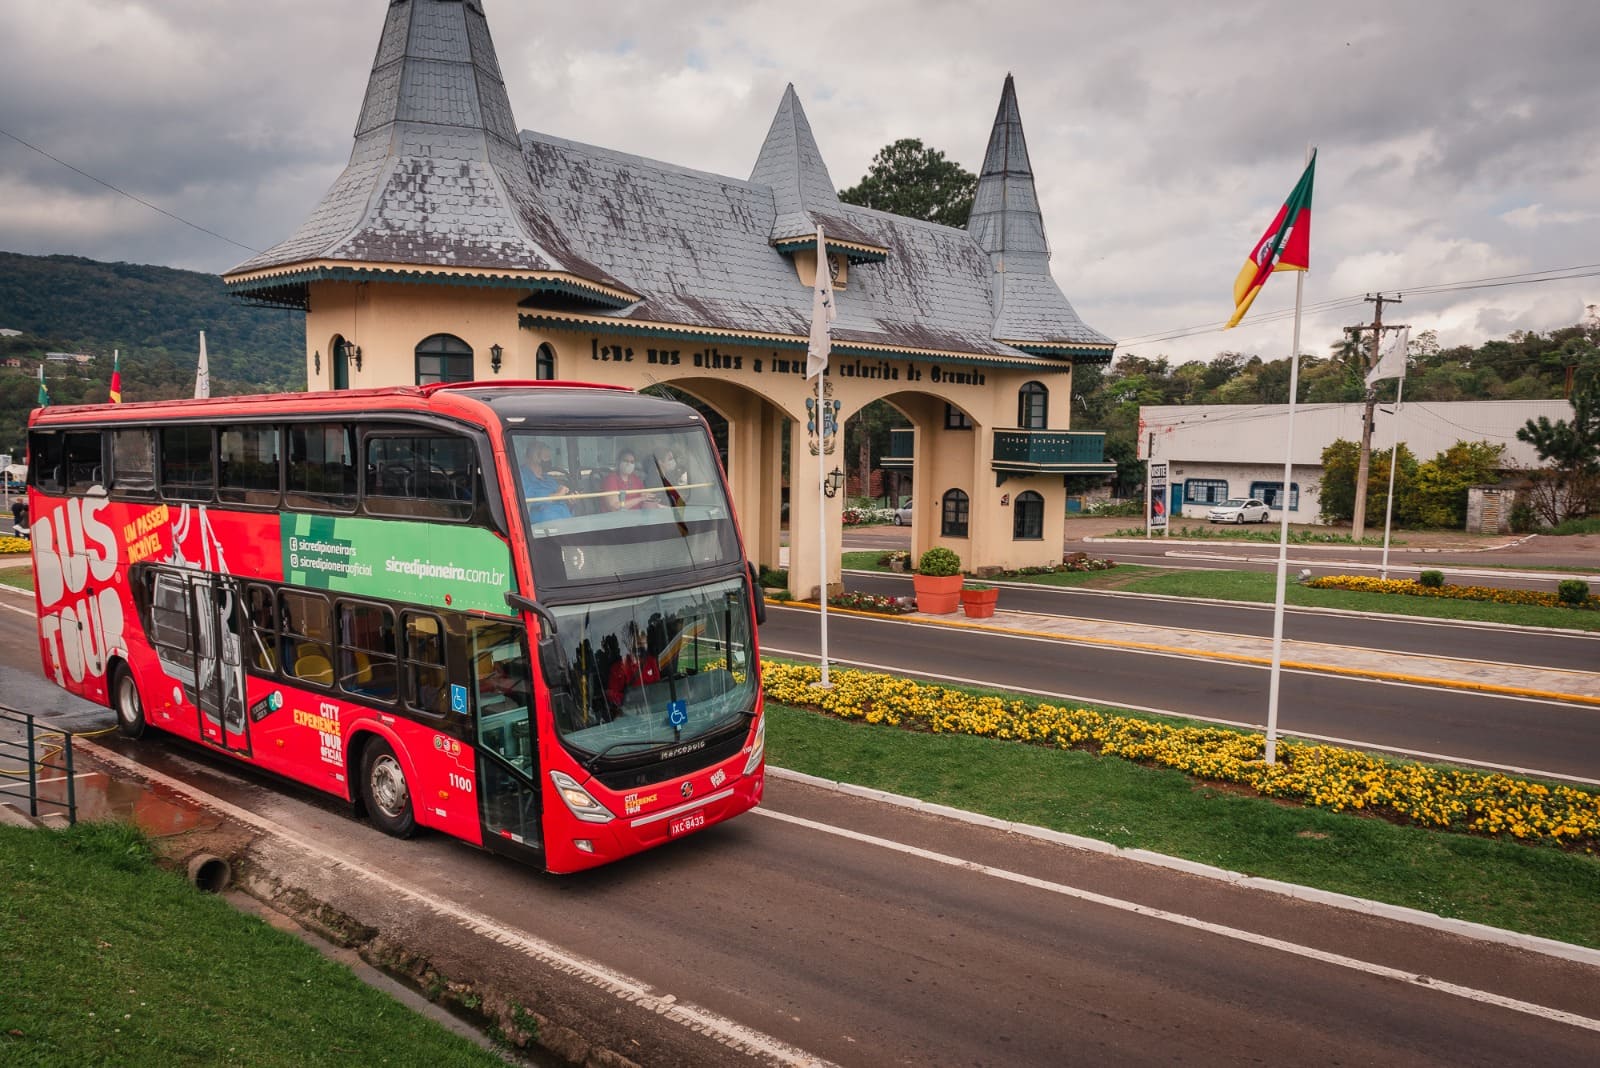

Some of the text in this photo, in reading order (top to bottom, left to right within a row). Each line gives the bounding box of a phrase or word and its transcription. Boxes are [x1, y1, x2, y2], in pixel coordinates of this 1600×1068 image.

[647, 348, 680, 365] nos
[693, 348, 743, 369] olhos
[753, 359, 762, 373] a
[840, 360, 899, 381] colorida
[907, 363, 922, 381] de
[931, 365, 986, 386] Gramado
[123, 503, 169, 543] UM PASSEIO
[31, 485, 118, 607] BUS
[128, 533, 163, 564] INCRÍVEL
[298, 539, 357, 558] sicredipioneirars
[299, 556, 373, 577] sicredipioneiraoficial
[385, 556, 505, 587] sicredipioneira.com.br
[41, 587, 129, 688] TOUR
[319, 702, 340, 721] CITY
[293, 708, 341, 736] EXPERIENCE
[319, 731, 342, 751] TOUR
[320, 747, 343, 762] OFICIAL
[449, 773, 472, 793] 1100
[625, 793, 638, 802] CITY
[625, 793, 658, 809] EXPERIENCE
[625, 805, 641, 815] TOUR
